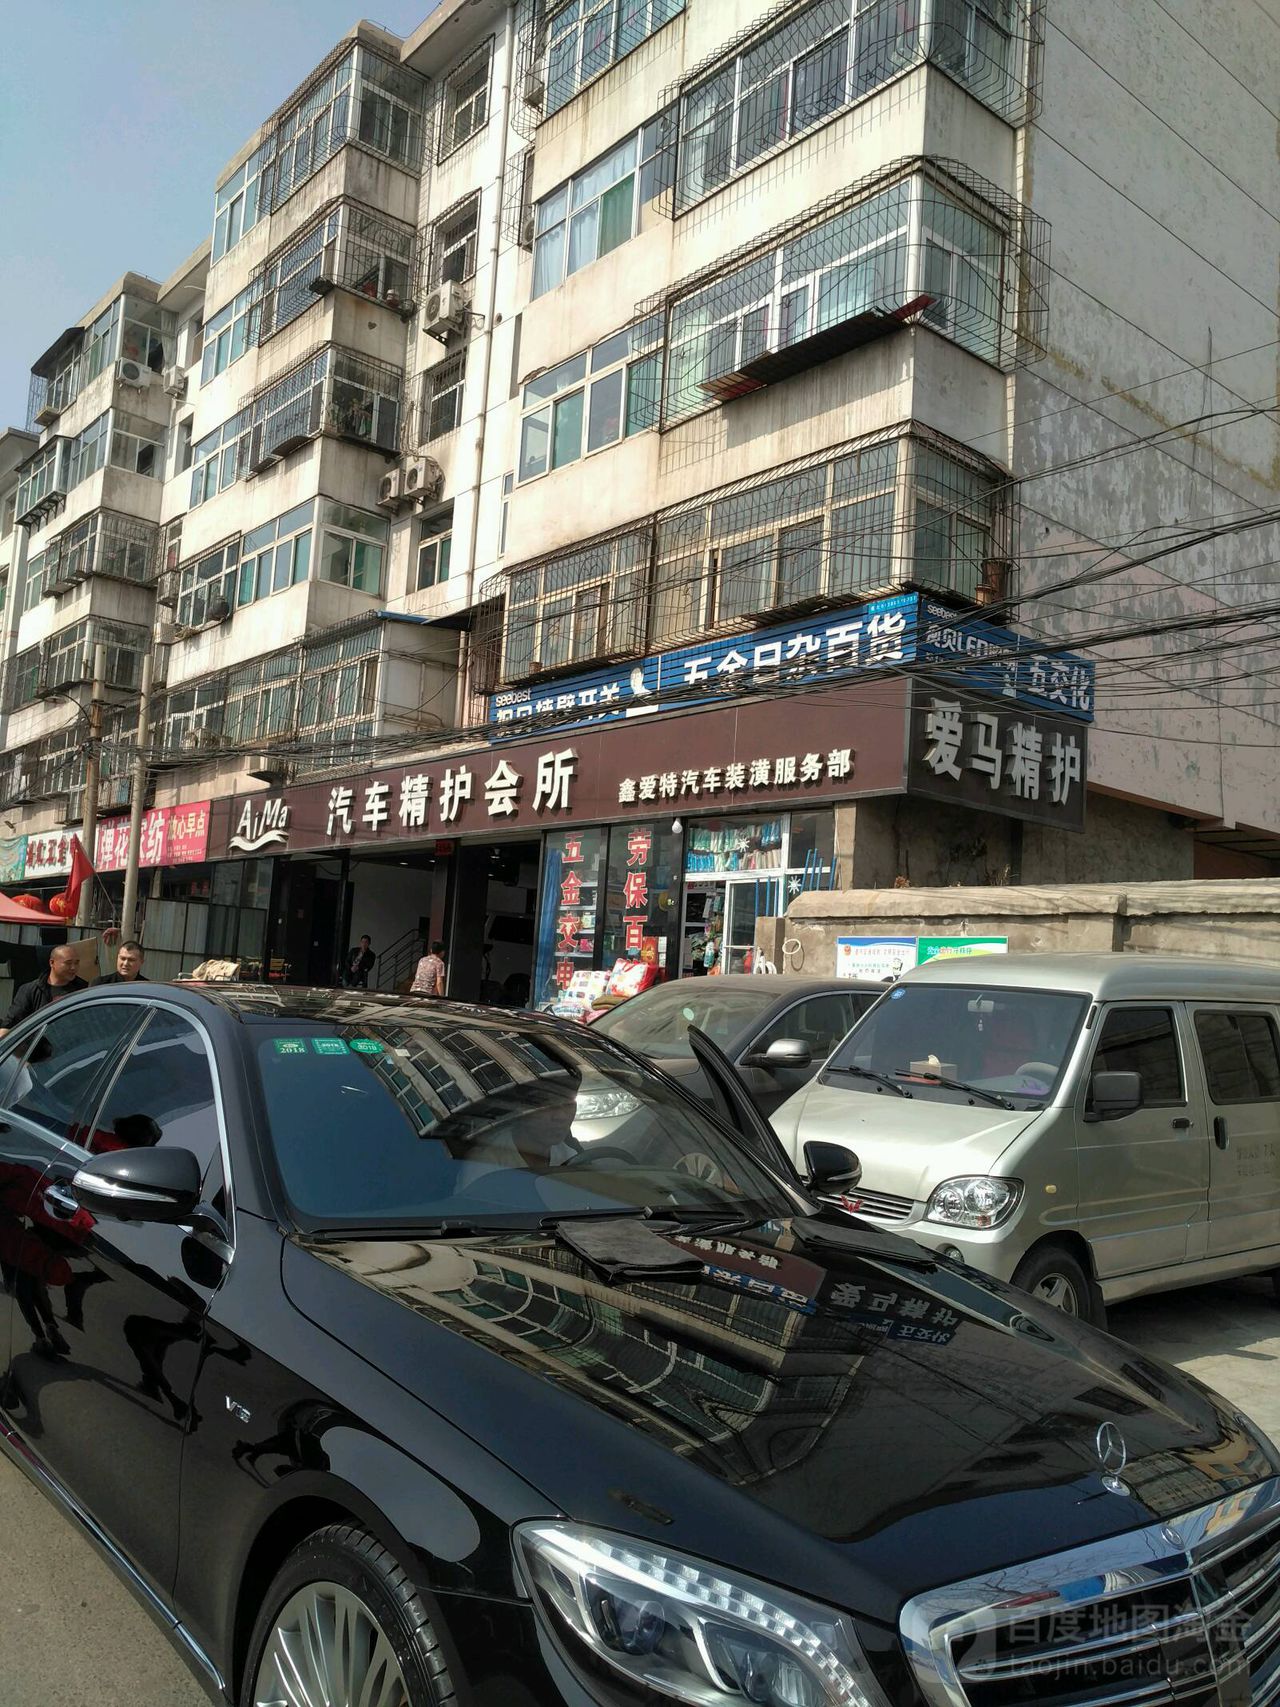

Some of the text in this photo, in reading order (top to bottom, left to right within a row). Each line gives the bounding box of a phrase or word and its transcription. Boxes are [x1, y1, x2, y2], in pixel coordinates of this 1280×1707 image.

[684, 611, 907, 692] 五金日杂百货
[495, 687, 532, 708] seebest
[326, 748, 576, 836] 汽车精护会所
[618, 748, 852, 804] 鑫爱特汽车装潢服务部
[923, 698, 1081, 805] 爱马精护
[236, 798, 289, 840] AiMa
[556, 832, 585, 990] 五金交电
